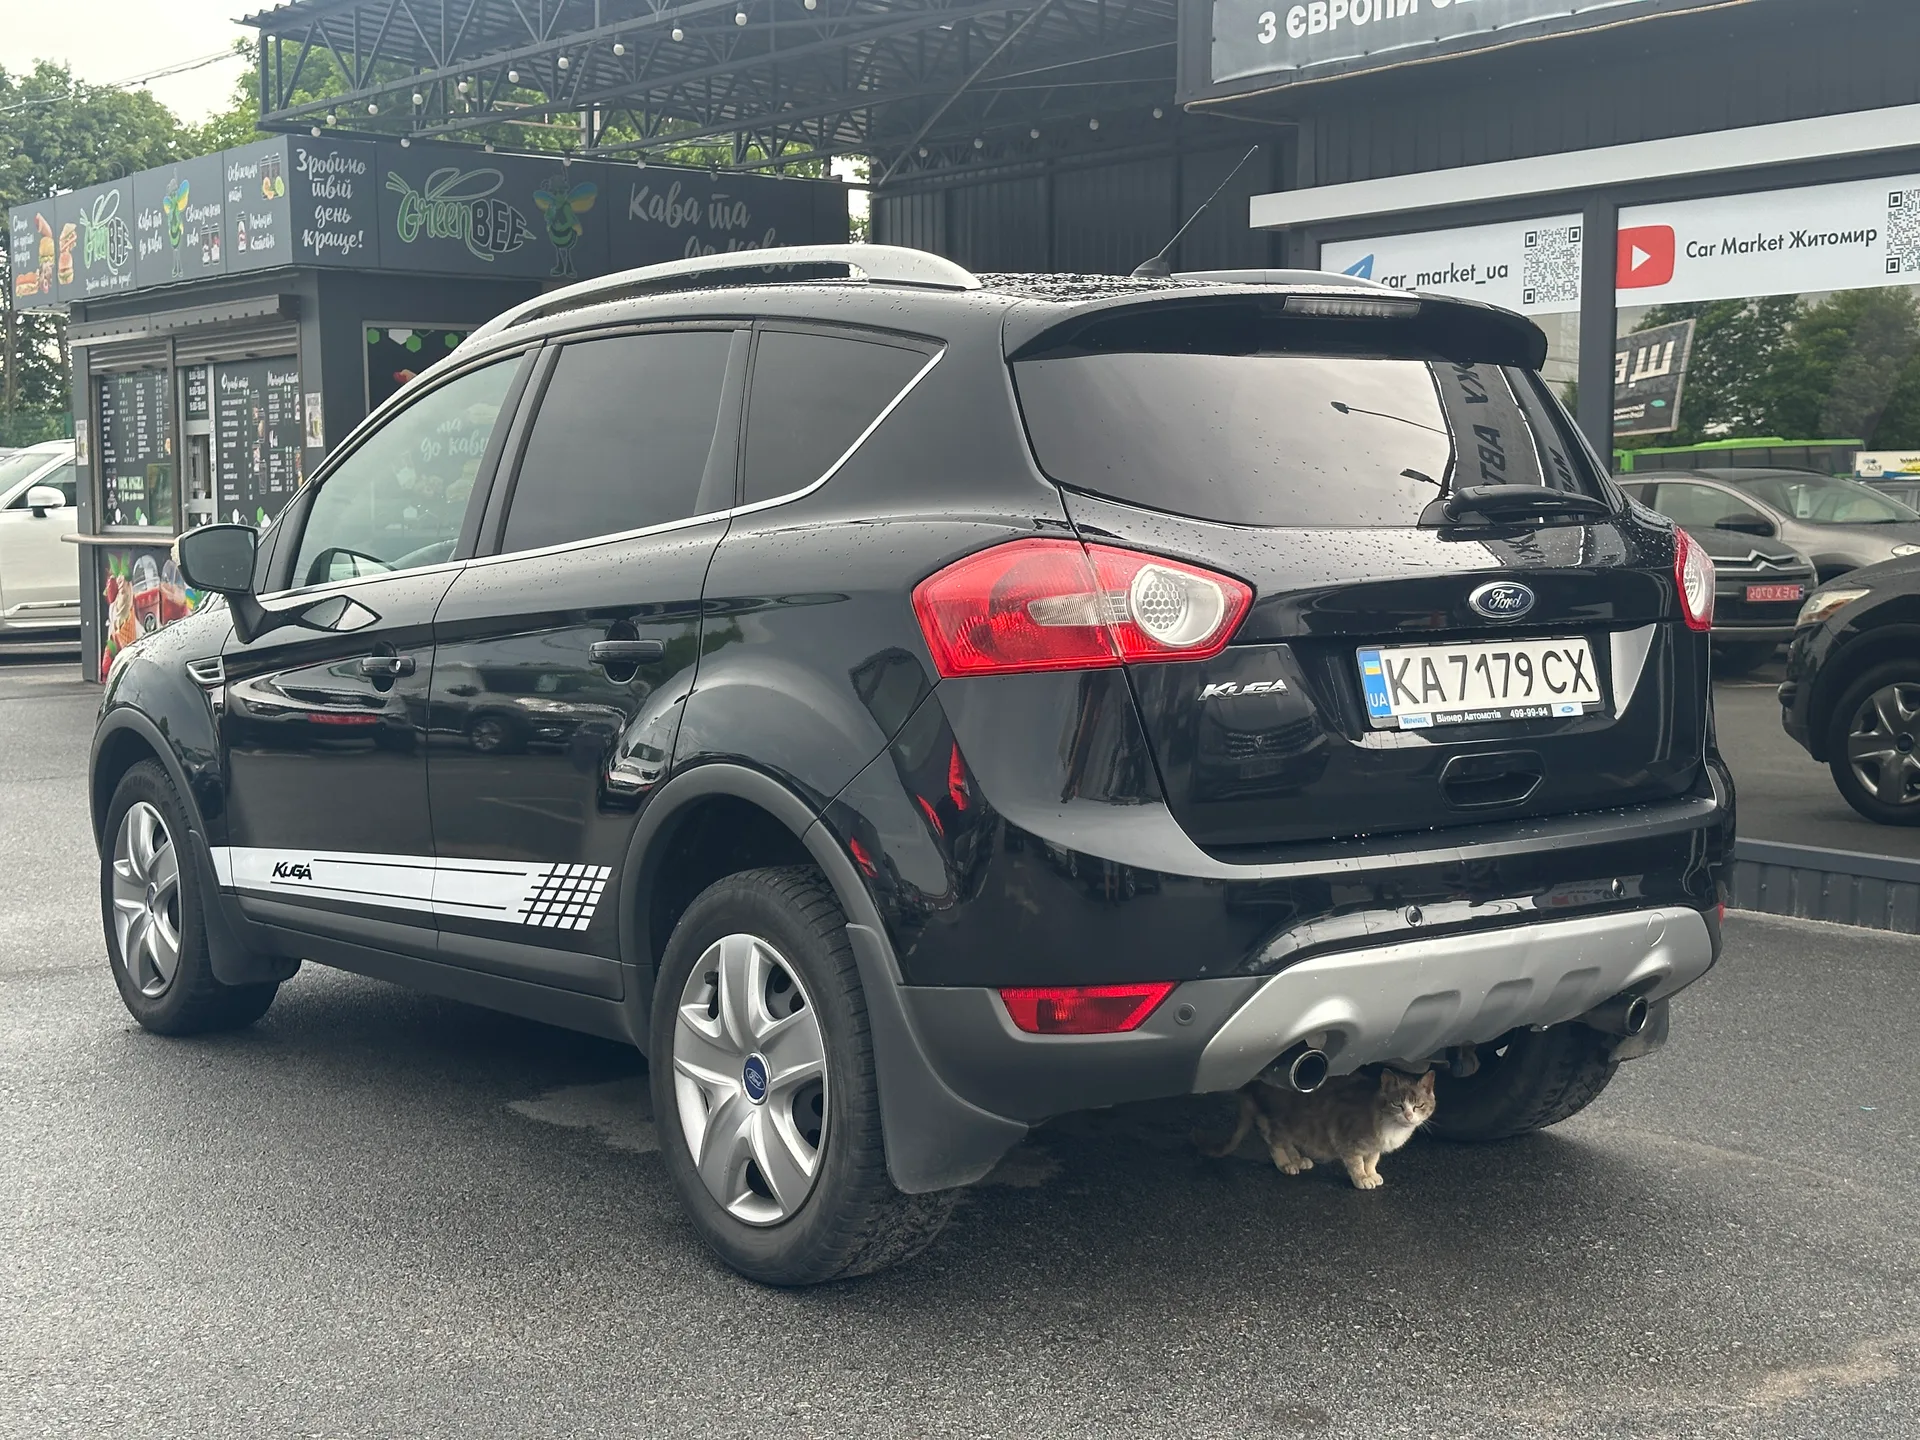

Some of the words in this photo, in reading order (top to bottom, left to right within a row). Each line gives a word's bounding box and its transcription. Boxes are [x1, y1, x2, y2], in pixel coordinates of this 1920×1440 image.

[296, 148, 367, 180] Зробимо
[311, 177, 354, 199] твій
[314, 204, 352, 229] день
[628, 180, 702, 229] Кава
[301, 229, 364, 256] краще!
[1685, 240, 1717, 259] Car
[1721, 232, 1785, 256] Market
[1788, 228, 1878, 249] Житомир
[1380, 262, 1509, 291] car_market_ua
[1488, 587, 1523, 610] Ford
[1197, 678, 1291, 702] KUGA
[1370, 692, 1389, 708] UA
[1509, 706, 1548, 719] 499-99-94
[271, 861, 313, 881] KUGA
